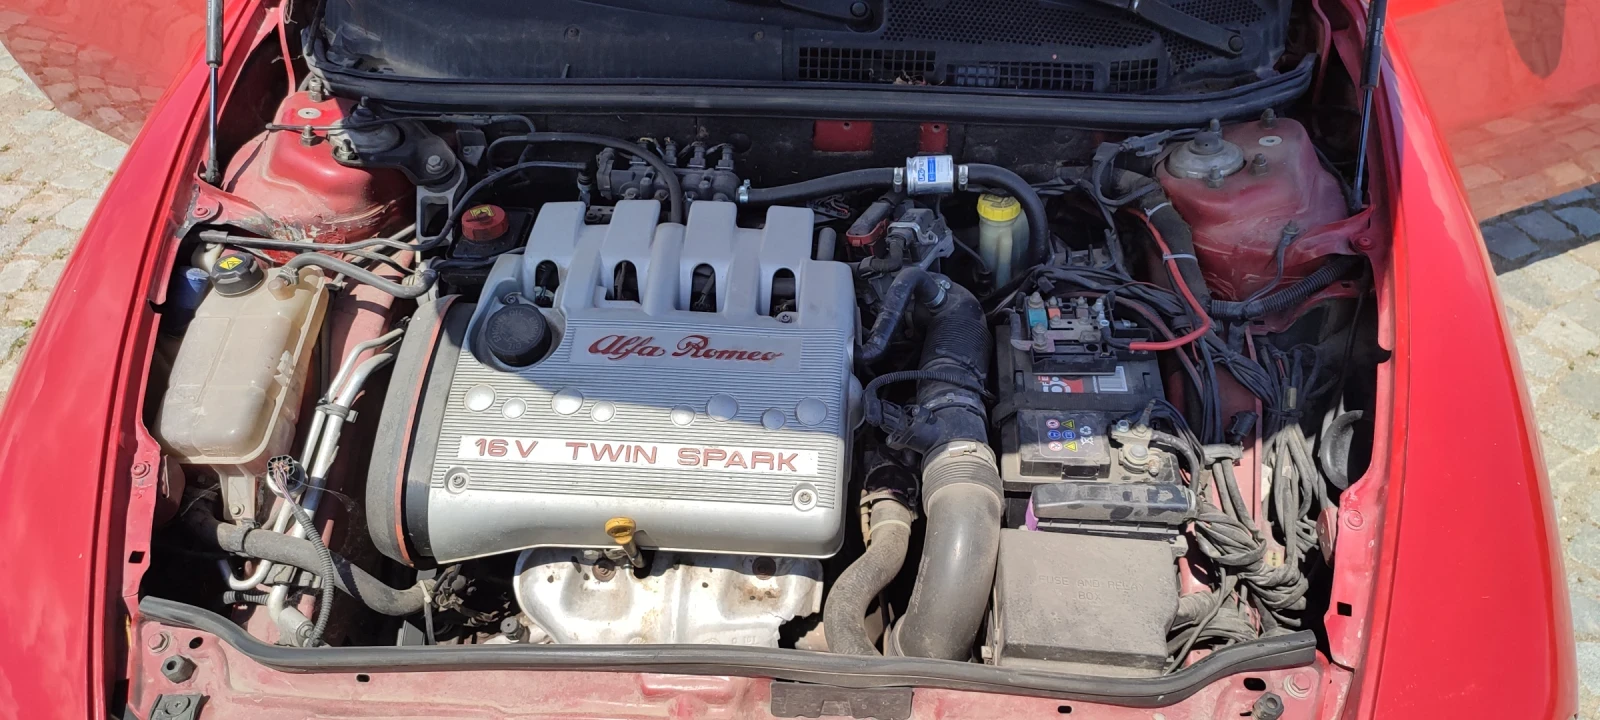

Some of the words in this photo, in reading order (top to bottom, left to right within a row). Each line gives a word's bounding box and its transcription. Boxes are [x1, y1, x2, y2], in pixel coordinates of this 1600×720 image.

[588, 334, 666, 361] Alfa
[672, 334, 784, 361] Romeo
[565, 442, 657, 464] TWIN
[677, 448, 798, 472] SPARK
[1039, 575, 1069, 586] FUSE
[1077, 579, 1100, 588] AND
[1107, 580, 1146, 591] RELAY
[1078, 591, 1102, 601] BOX
